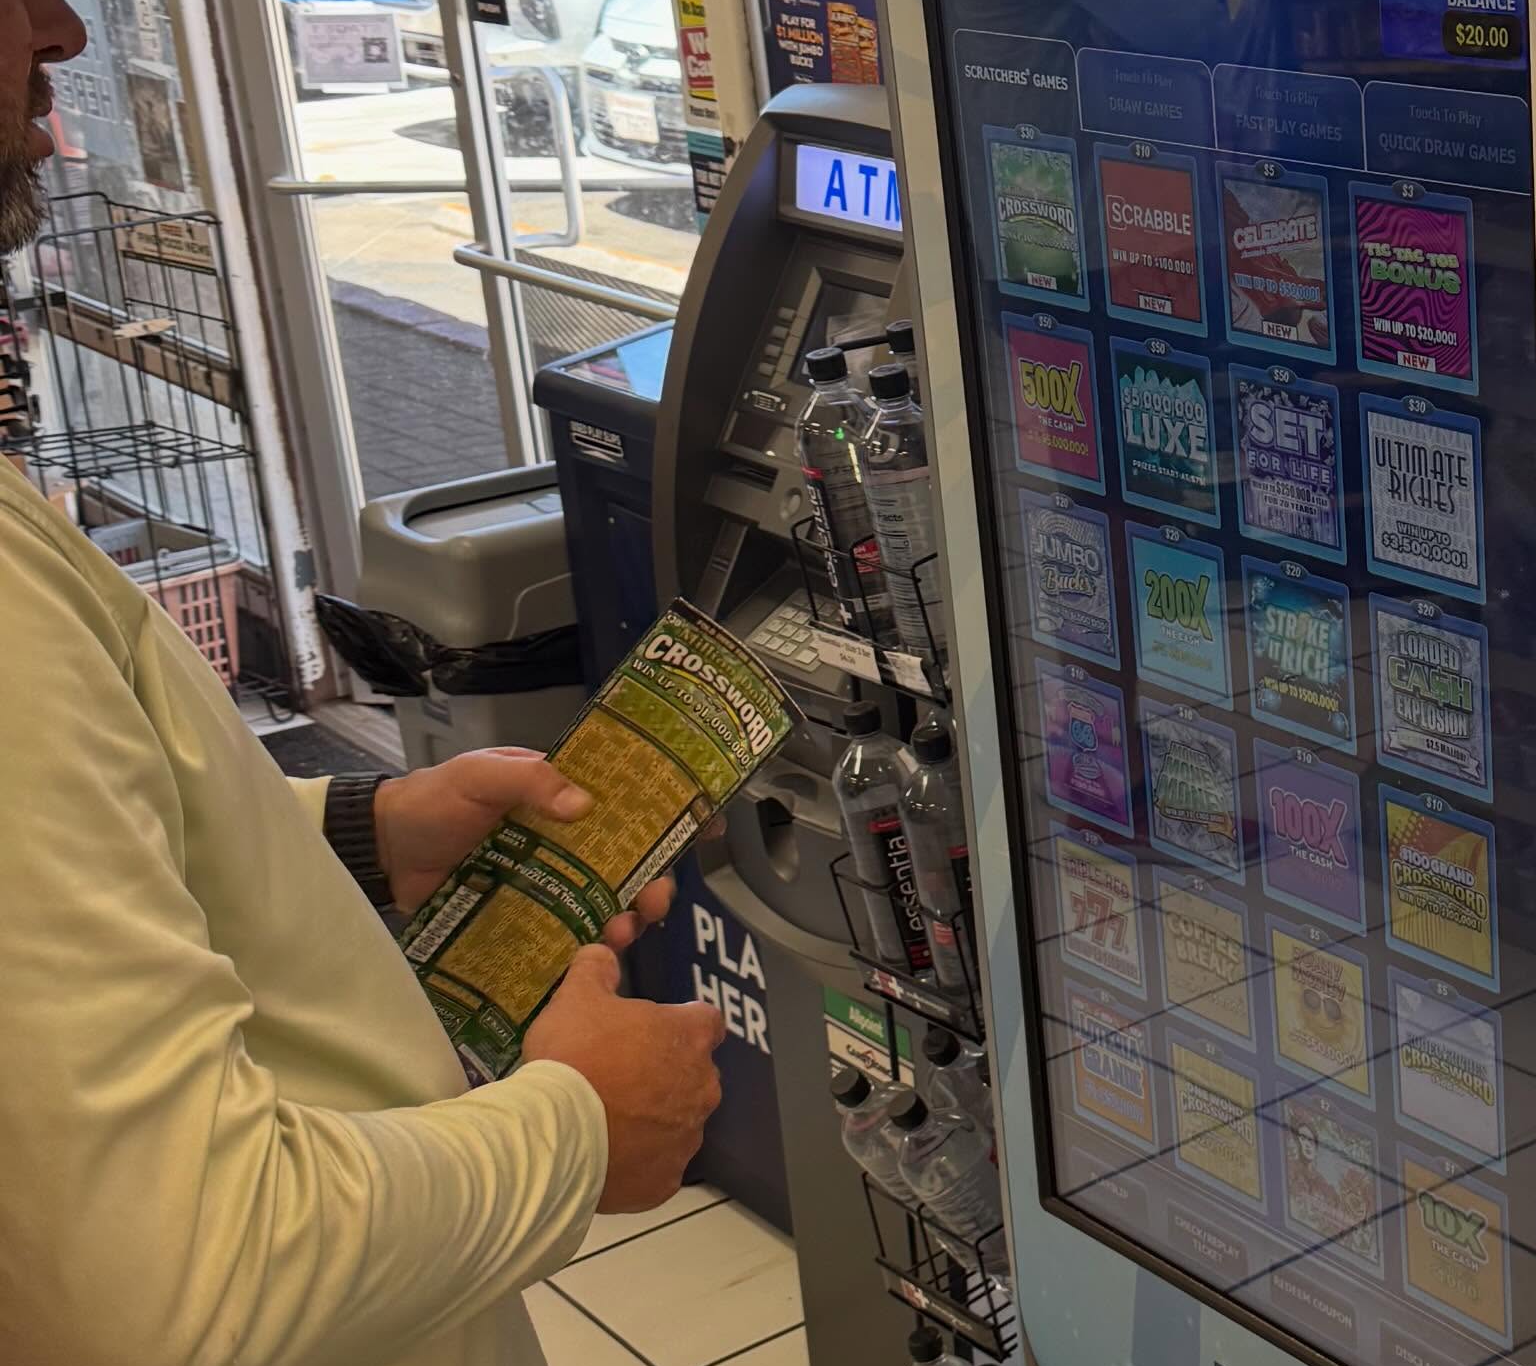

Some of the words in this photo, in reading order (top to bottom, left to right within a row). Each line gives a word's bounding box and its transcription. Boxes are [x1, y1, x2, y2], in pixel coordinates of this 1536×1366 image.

[1455, 23, 1509, 48] $20.00
[1379, 133, 1421, 153] QUICK
[1424, 137, 1466, 159] DRAW
[1468, 145, 1517, 164] GAMES
[998, 197, 1075, 234] CROSSWORD
[1111, 202, 1192, 235] SCRABBLE
[1370, 259, 1461, 295] BONUS
[1019, 358, 1086, 426] 500X
[1123, 406, 1208, 463] LUXE
[1250, 400, 1325, 460] SET
[1247, 449, 1281, 473] FOR
[1288, 457, 1333, 485] LIFE
[1374, 436, 1468, 488] ULTIMATE
[1389, 470, 1455, 515] RICHES
[1034, 533, 1099, 572] JUMBO
[1145, 569, 1213, 642] 200X
[1399, 632, 1460, 671] LOADED
[644, 634, 773, 756] CROSSWORD
[1395, 695, 1469, 738] EXPLOSION
[1270, 787, 1348, 868] 100X
[1391, 859, 1488, 920] CROSSWORD
[693, 904, 767, 992] PLA
[1418, 1191, 1488, 1263] 10X
